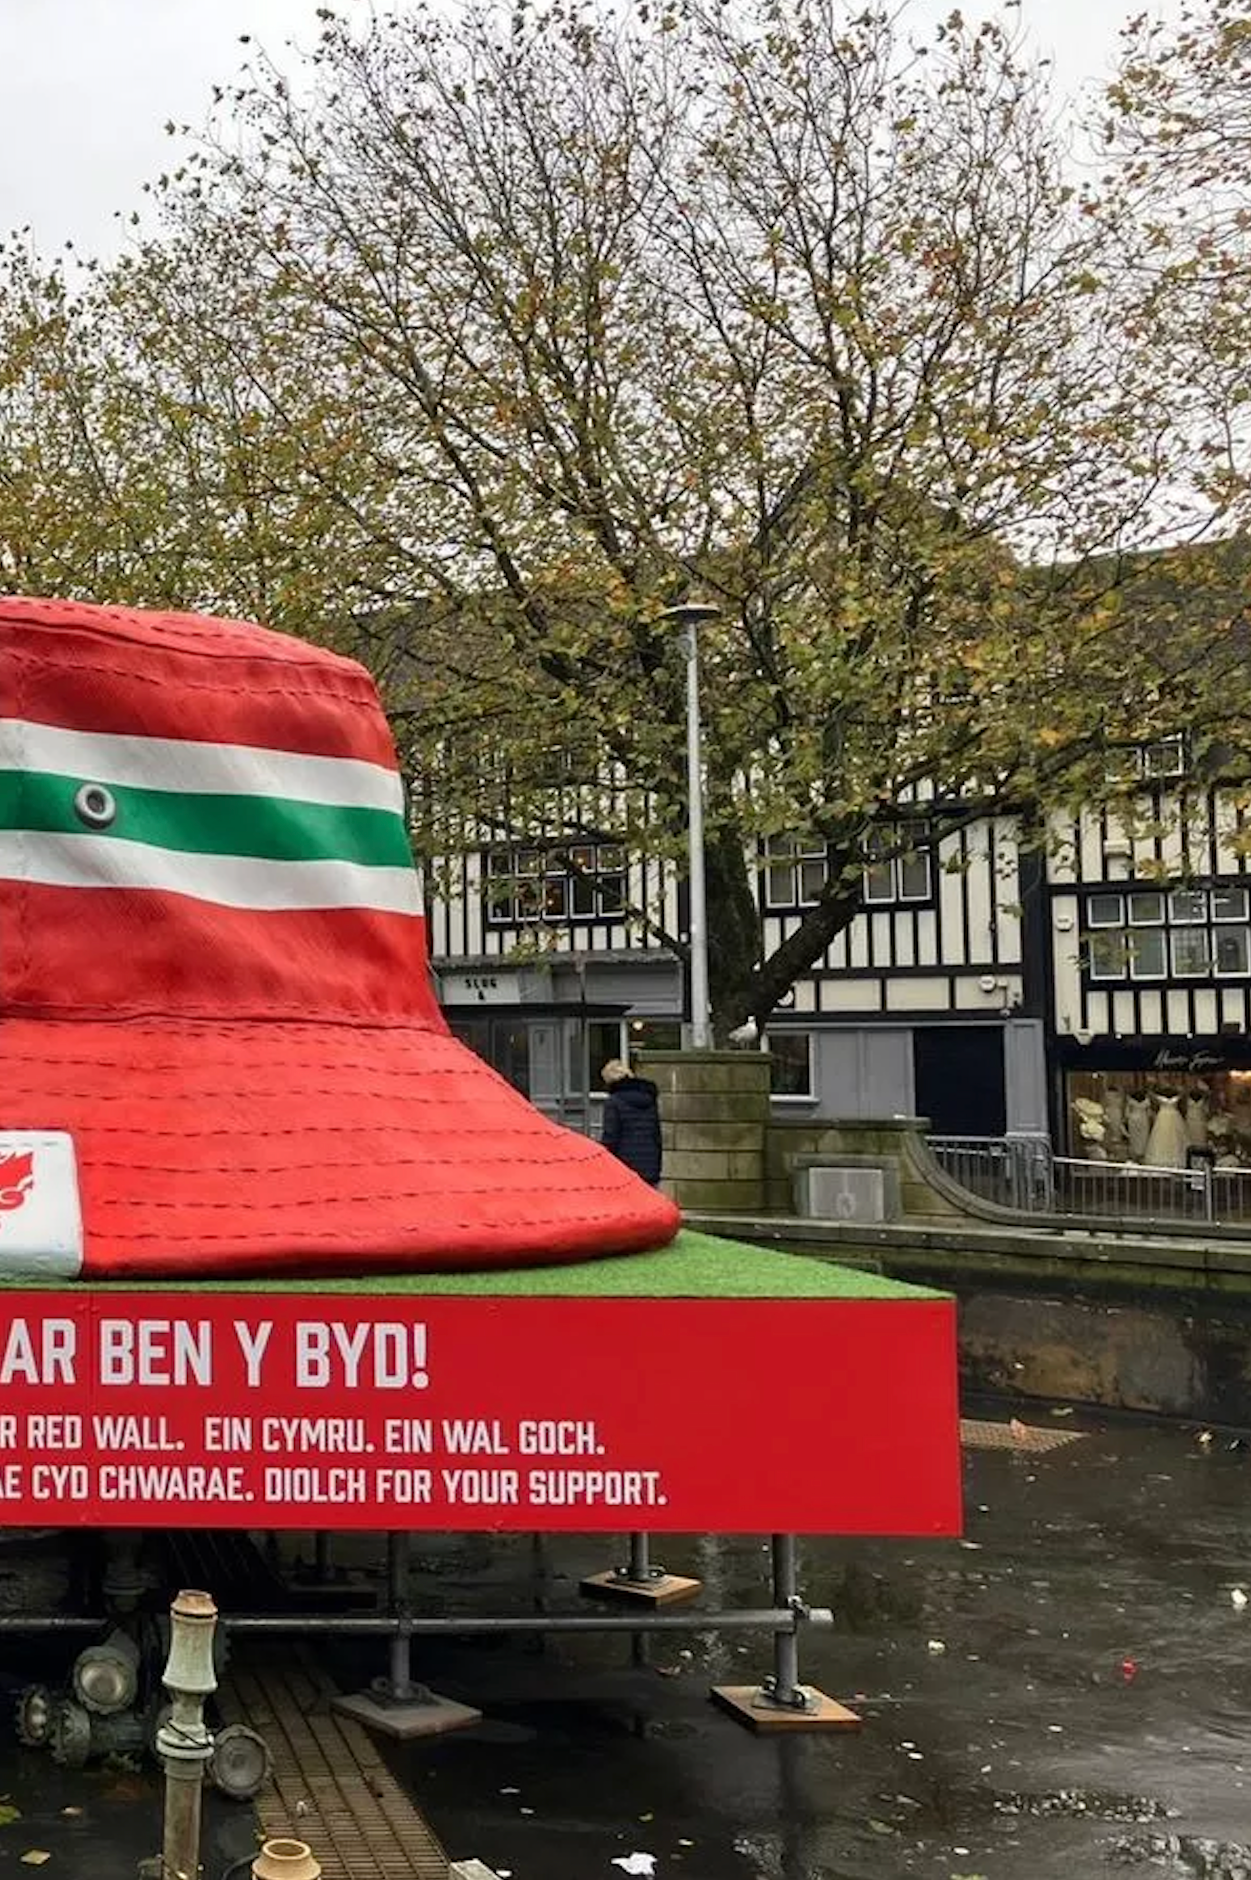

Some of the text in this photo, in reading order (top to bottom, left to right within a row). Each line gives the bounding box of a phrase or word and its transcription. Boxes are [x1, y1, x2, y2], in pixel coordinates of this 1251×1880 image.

[100, 1319, 213, 1386] BEN
[233, 1320, 274, 1387] Y
[295, 1321, 430, 1389] BYD!
[27, 1414, 82, 1449] RED
[92, 1415, 185, 1451] WALL.
[205, 1416, 252, 1452] EIN
[262, 1417, 375, 1453] CYMRU.
[385, 1418, 433, 1454] EIN
[442, 1419, 510, 1455] WAL
[518, 1420, 606, 1455] GOCH.
[32, 1464, 89, 1500] CYD
[99, 1465, 255, 1501] CHWARAE.
[264, 1467, 366, 1503] DIOLCH
[376, 1469, 433, 1504] FOR
[441, 1469, 520, 1505] YOUR
[529, 1470, 668, 1506] SUPPORT.
